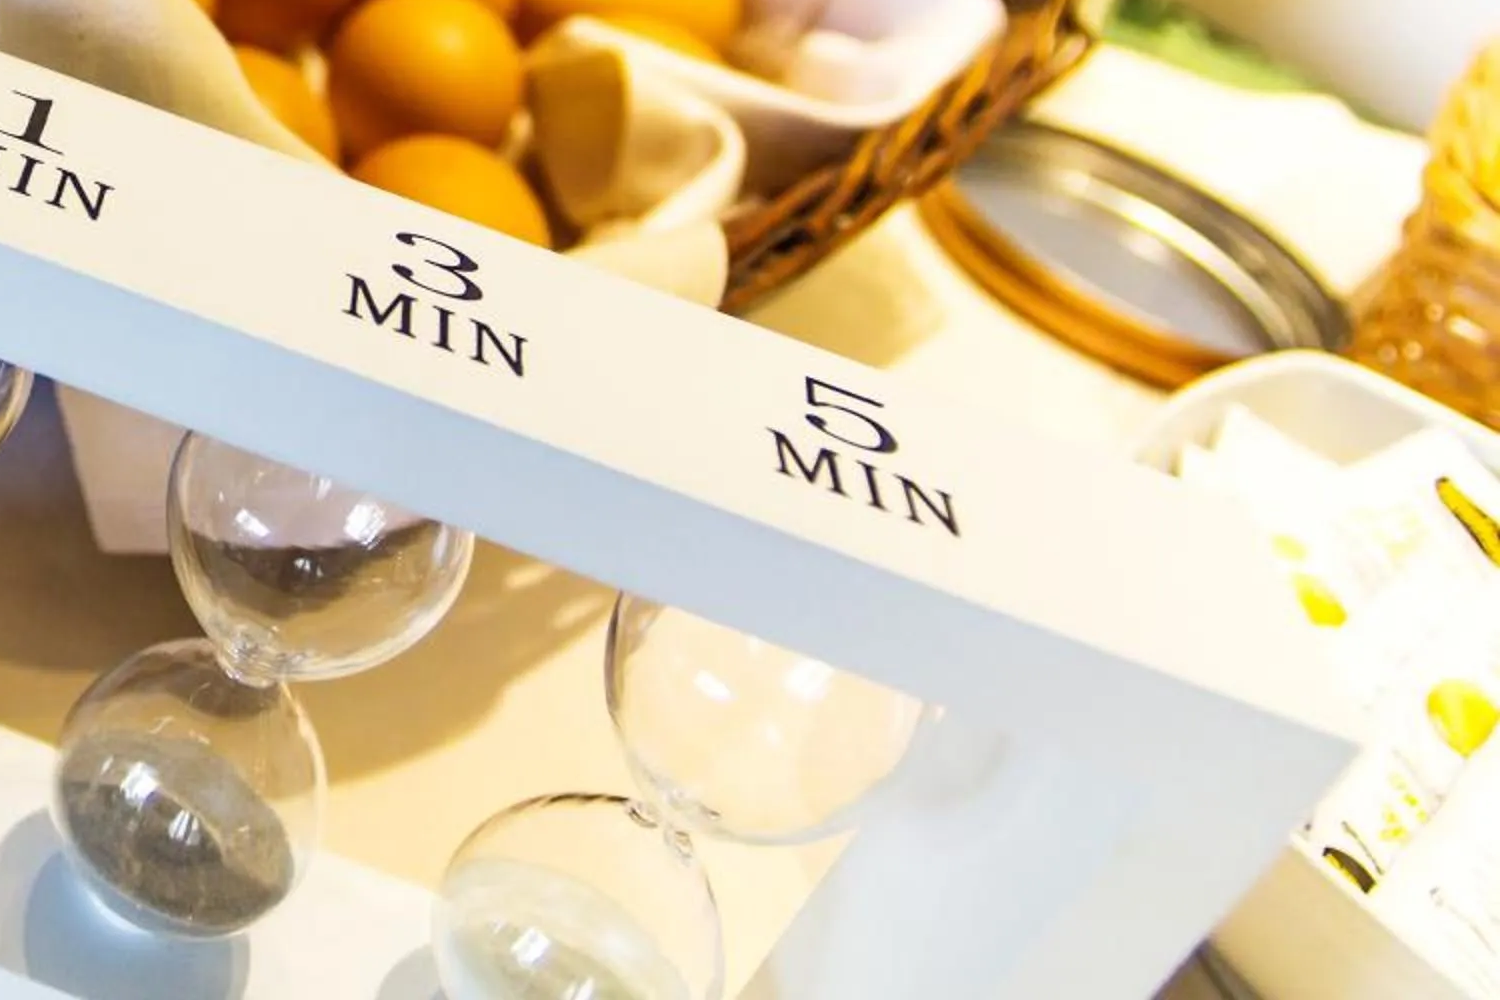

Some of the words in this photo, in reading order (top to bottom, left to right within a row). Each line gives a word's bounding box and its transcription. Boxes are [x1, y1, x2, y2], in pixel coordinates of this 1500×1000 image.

[390, 231, 484, 302] 3
[341, 272, 529, 379] MIN
[804, 375, 899, 455] 5
[764, 426, 961, 538] MIN
